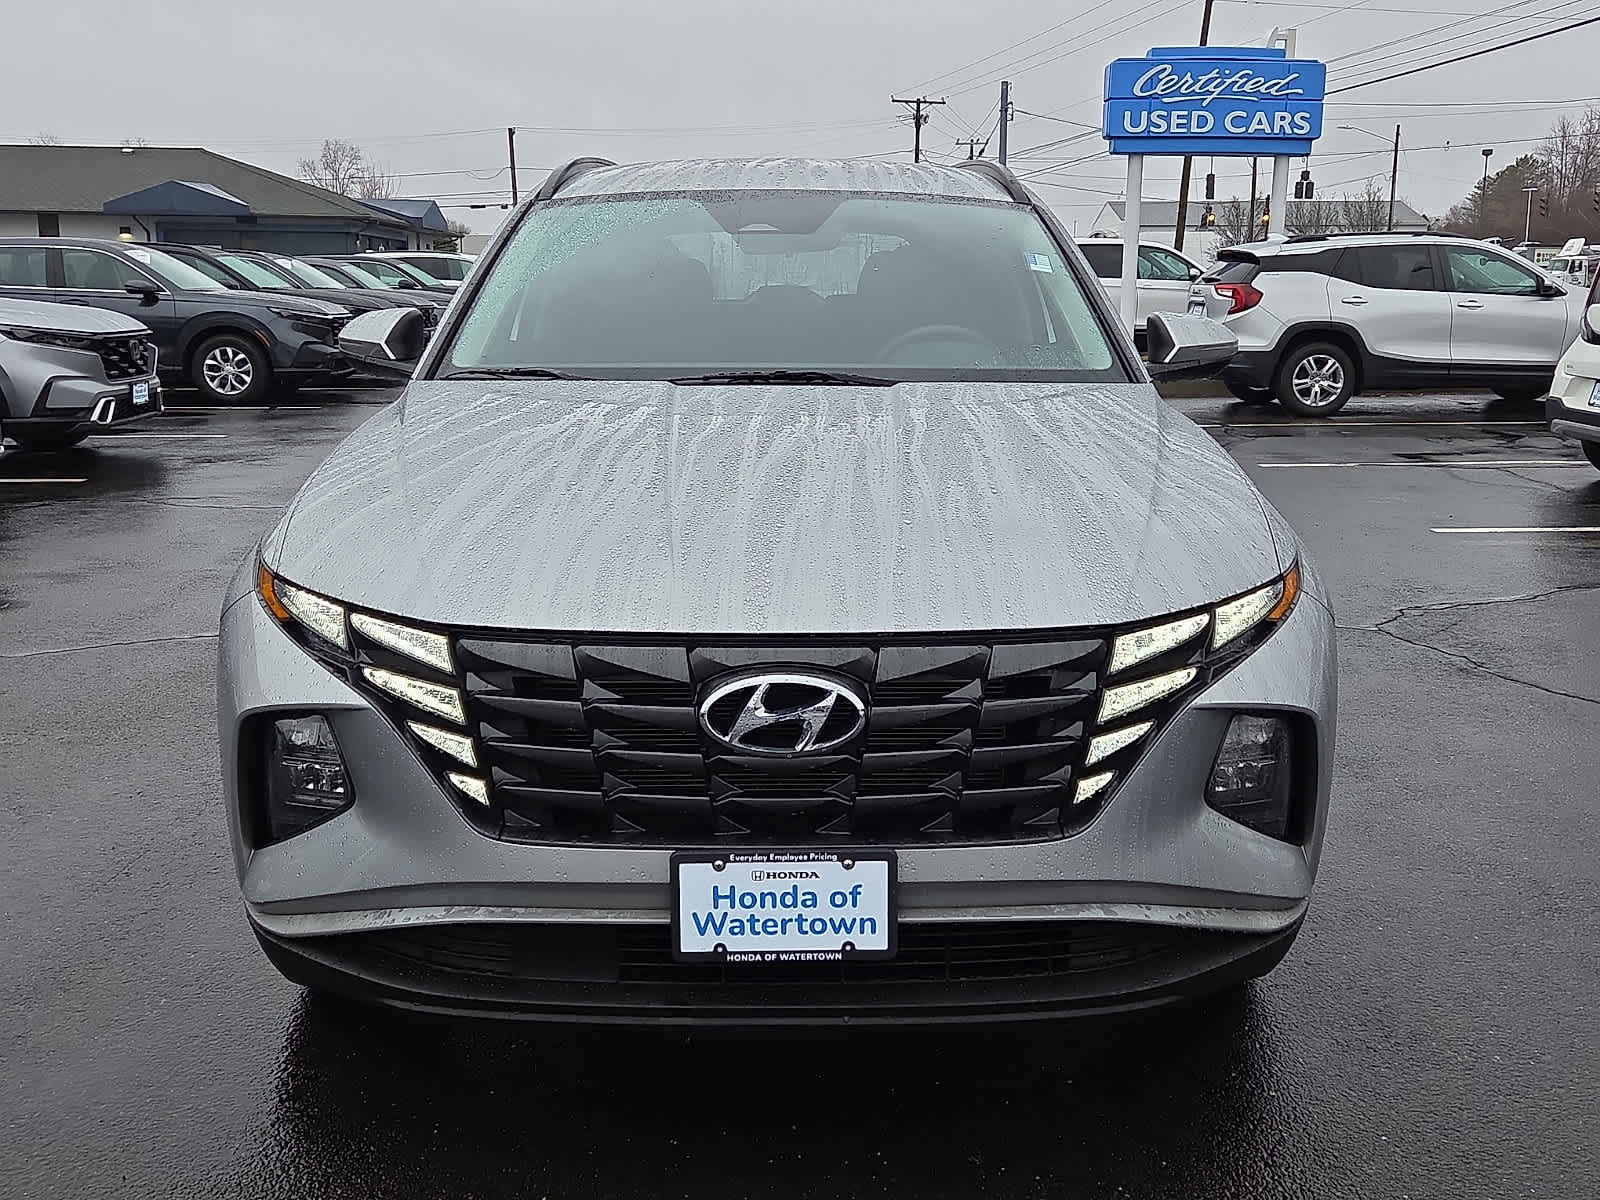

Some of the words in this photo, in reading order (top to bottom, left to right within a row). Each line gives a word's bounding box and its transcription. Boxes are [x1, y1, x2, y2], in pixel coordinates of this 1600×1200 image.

[1133, 64, 1303, 106] Certified
[1124, 110, 1214, 134] USED
[1224, 110, 1311, 134] CARS
[730, 853, 766, 863] Everyday
[769, 852, 806, 862] Employee
[809, 852, 837, 862] Pricing
[766, 871, 820, 879] HONDA
[713, 885, 817, 909] Honda
[829, 884, 862, 908] of
[692, 912, 877, 936] Watertown
[727, 953, 761, 962] HONDA
[764, 953, 777, 961] OF
[779, 952, 842, 961] WATERTOWN
